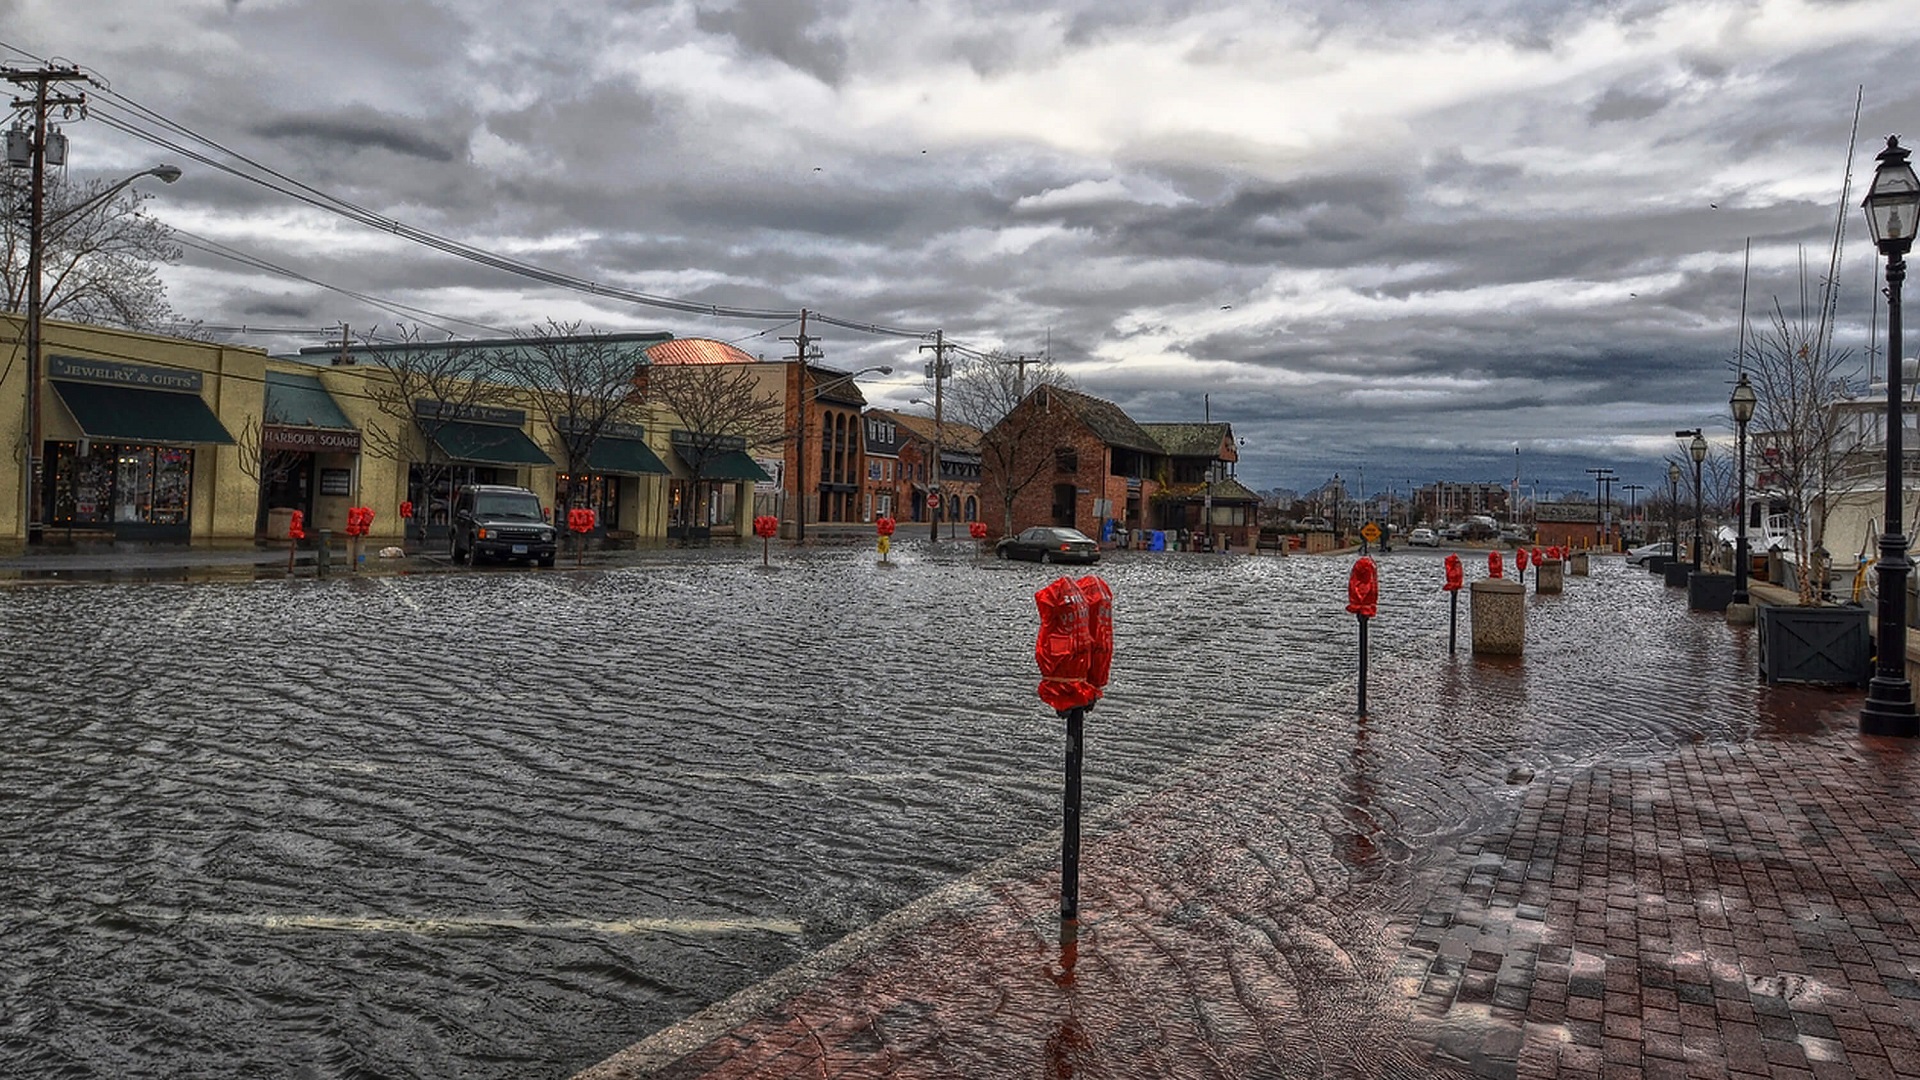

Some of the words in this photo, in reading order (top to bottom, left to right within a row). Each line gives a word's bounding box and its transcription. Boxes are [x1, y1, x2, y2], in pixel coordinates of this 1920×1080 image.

[64, 364, 134, 381] JEWELRY
[137, 370, 149, 383] &
[152, 374, 192, 388] GIFTS
[264, 431, 315, 445] HARBOUR
[319, 435, 359, 448] SQUARE
